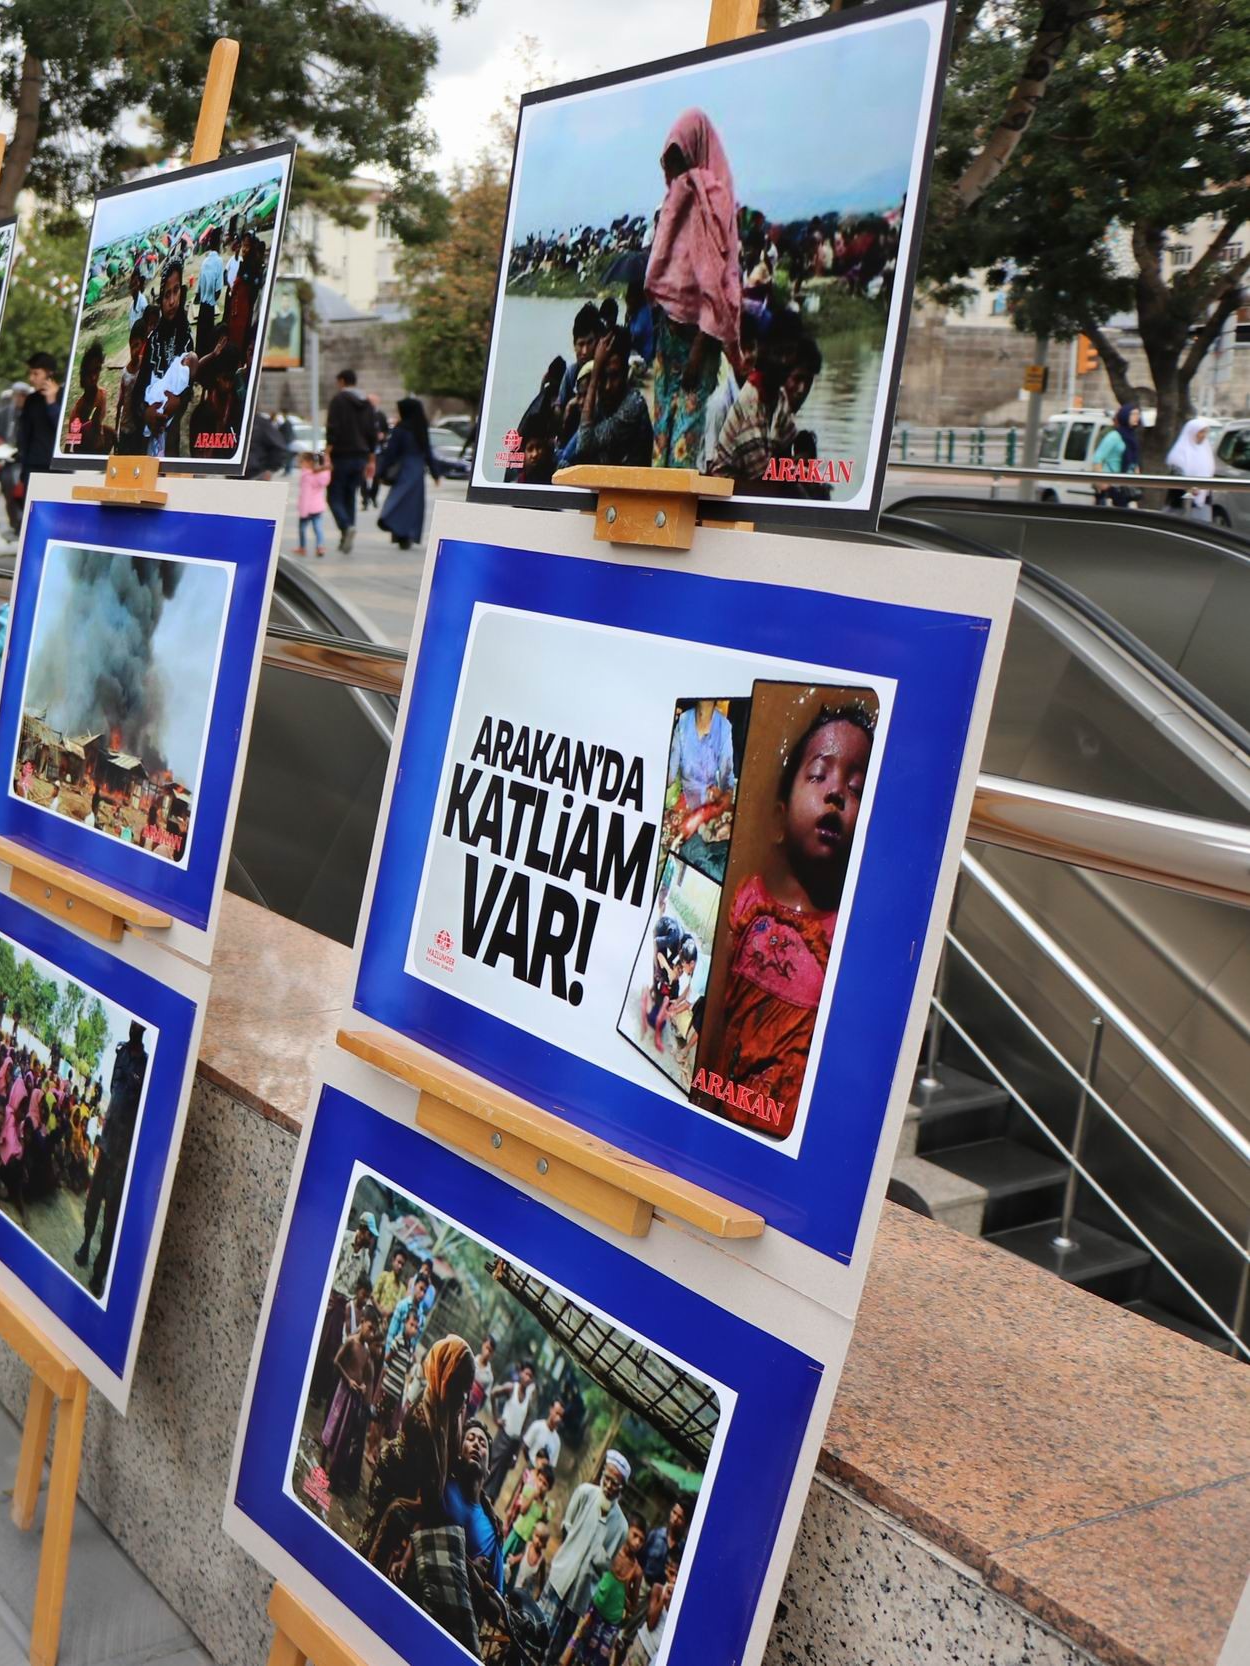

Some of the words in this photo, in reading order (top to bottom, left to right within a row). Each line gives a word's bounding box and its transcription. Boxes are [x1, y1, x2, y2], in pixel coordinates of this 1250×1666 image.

[194, 432, 237, 449] ARAKAN
[762, 457, 855, 484] ARAKAN
[470, 715, 644, 812] ARAKAN'DA
[461, 852, 601, 1007] VAR!
[691, 1067, 786, 1127] ARAKAN
